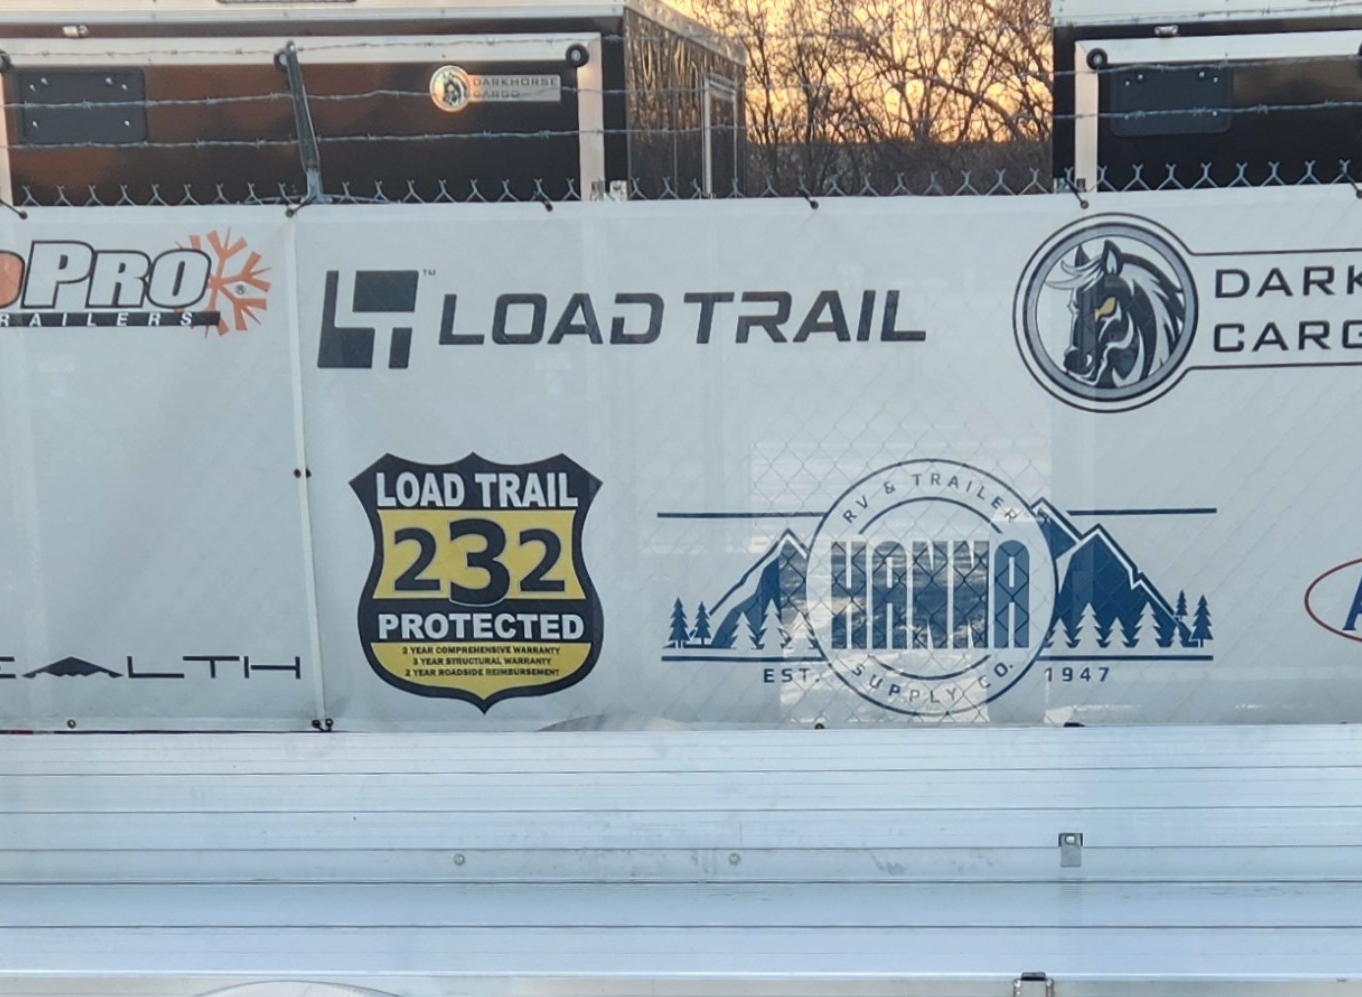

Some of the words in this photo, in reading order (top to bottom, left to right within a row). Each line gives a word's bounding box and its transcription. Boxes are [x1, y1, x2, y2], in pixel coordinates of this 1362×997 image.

[473, 77, 558, 87] DARKHORSE
[473, 90, 521, 99] CARGO
[439, 292, 665, 346] LOAD
[683, 289, 927, 344] TRAIL
[375, 472, 466, 508] LOAD
[474, 472, 579, 508] TRAIL
[842, 495, 871, 524] RV
[883, 479, 897, 494] &
[910, 472, 1020, 522] TRAILER
[393, 517, 566, 607] 232
[830, 538, 1031, 650] HANNA
[378, 612, 585, 640] PROTECTED
[410, 646, 433, 655] YEAR
[435, 646, 511, 655] COMPREHENSIVE
[513, 646, 561, 655] WARRANTY
[421, 658, 444, 666] YEAR
[446, 657, 502, 666] STRUCTURAL
[504, 657, 552, 666] WARRANTY
[414, 669, 437, 677] YEAR
[438, 668, 484, 677] ROADSIDE
[486, 668, 560, 677] REIMBURSEMENT
[763, 667, 820, 684] EST.
[1045, 666, 1110, 683] 1947
[851, 662, 959, 705] SUPPLY
[979, 661, 1014, 690] CO.
